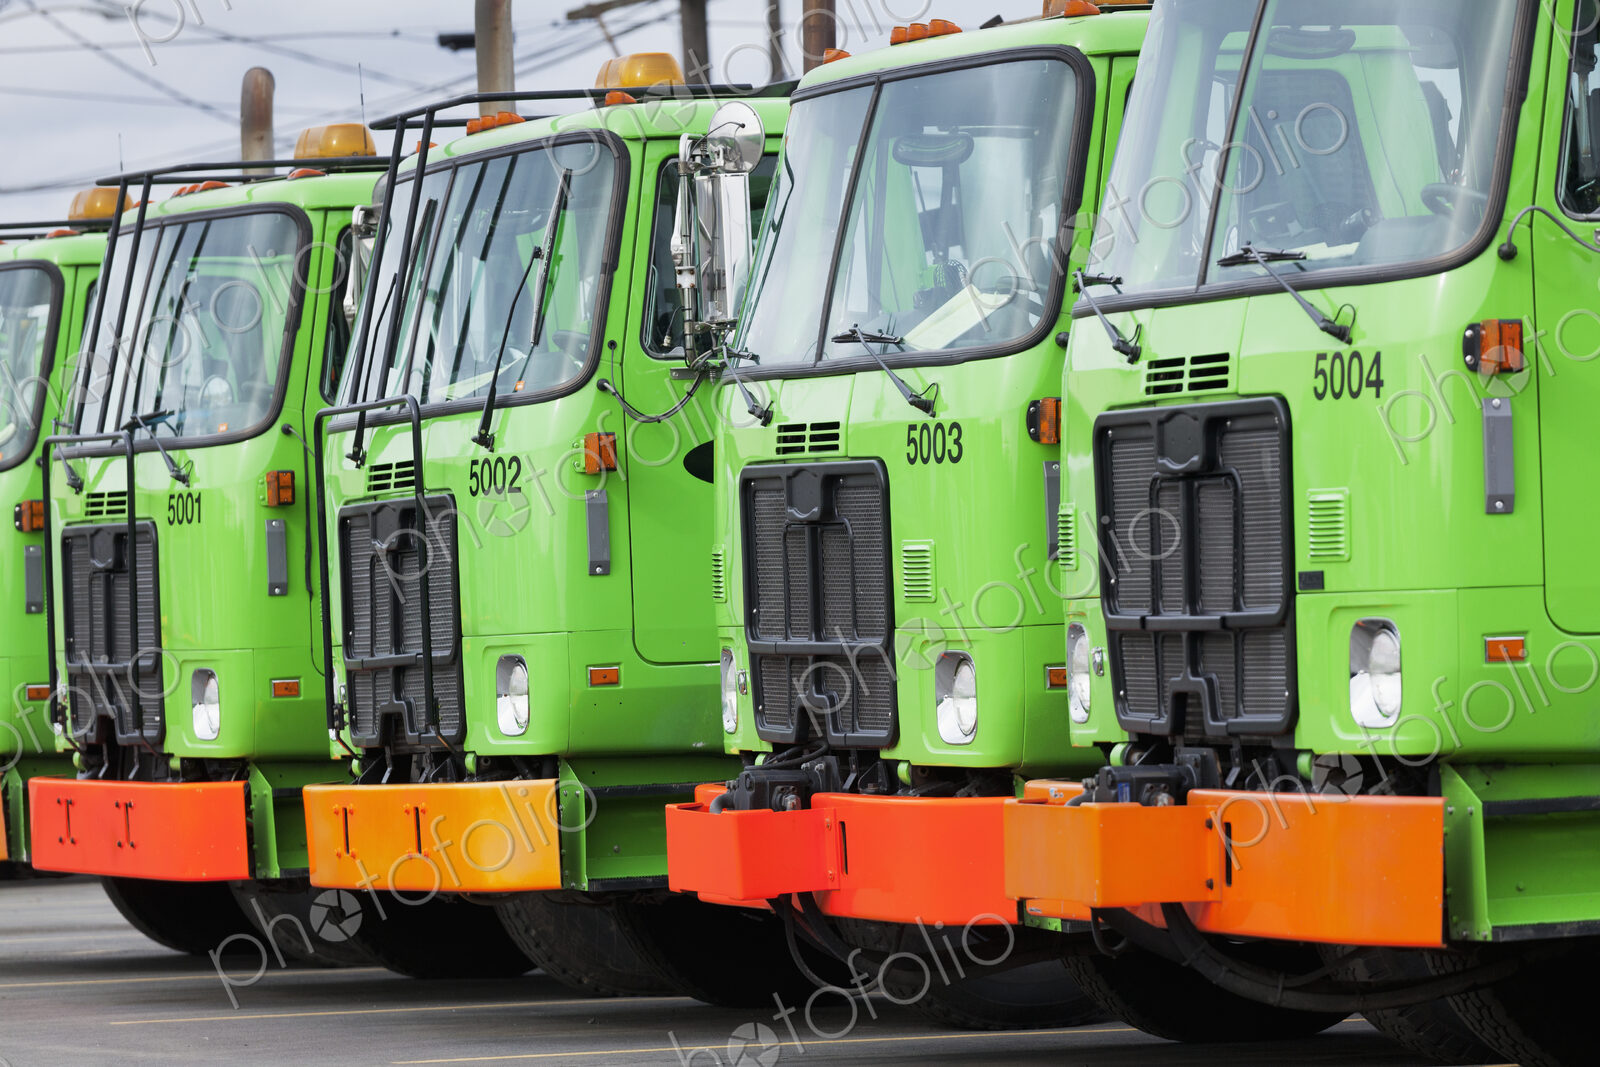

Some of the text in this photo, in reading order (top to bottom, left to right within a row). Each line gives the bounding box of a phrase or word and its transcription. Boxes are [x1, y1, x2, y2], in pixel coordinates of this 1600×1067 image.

[1313, 351, 1384, 401] 5004
[906, 422, 963, 466] 5003
[469, 456, 522, 497] 5002
[167, 493, 201, 526] 5001
